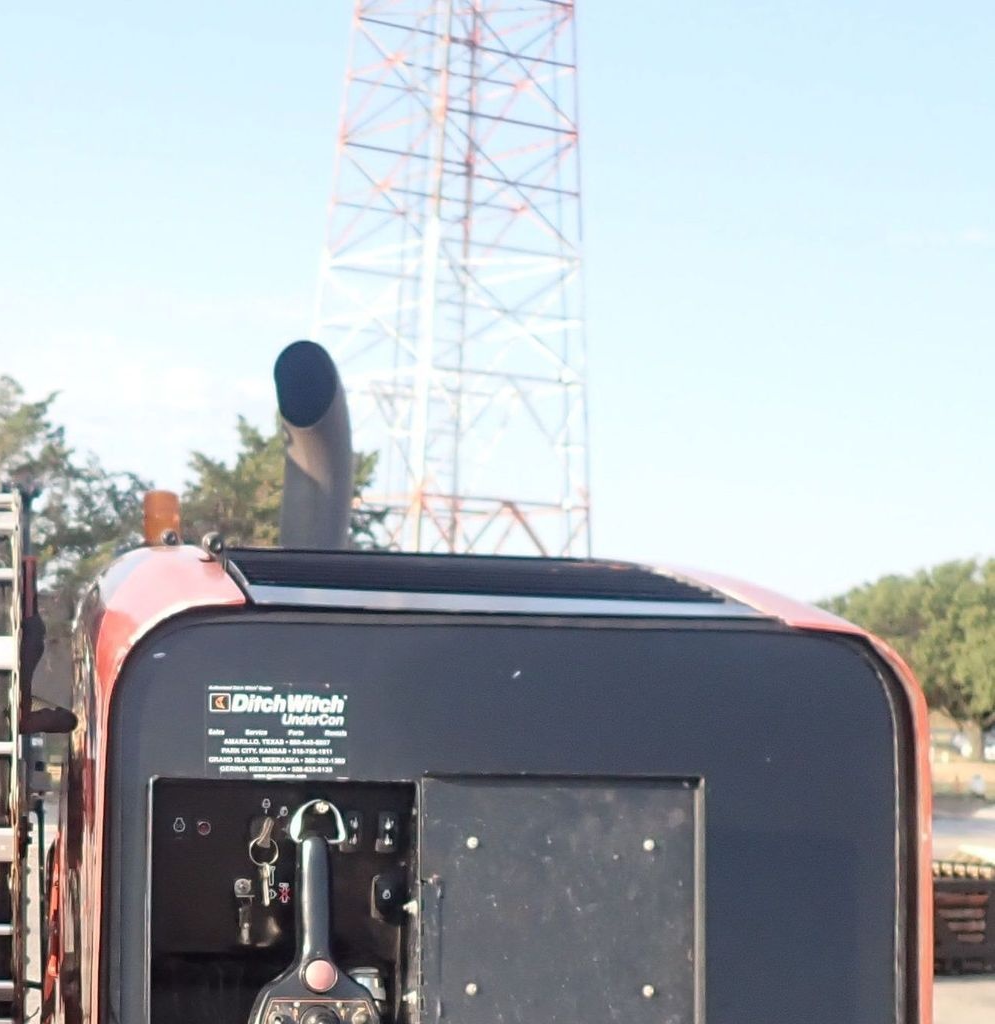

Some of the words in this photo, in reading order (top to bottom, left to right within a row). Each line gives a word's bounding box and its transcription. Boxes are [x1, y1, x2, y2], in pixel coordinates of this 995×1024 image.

[231, 693, 286, 713] Ditch
[287, 693, 345, 713] Witch
[281, 713, 345, 726] UnderCon
[208, 728, 225, 736] Sales
[244, 728, 268, 736] Service
[261, 738, 285, 746] TEXAS
[220, 747, 240, 755] PARK
[208, 756, 233, 764] GRAND
[261, 756, 300, 764] NEBRASKA
[248, 765, 287, 773] NEBRASKA
